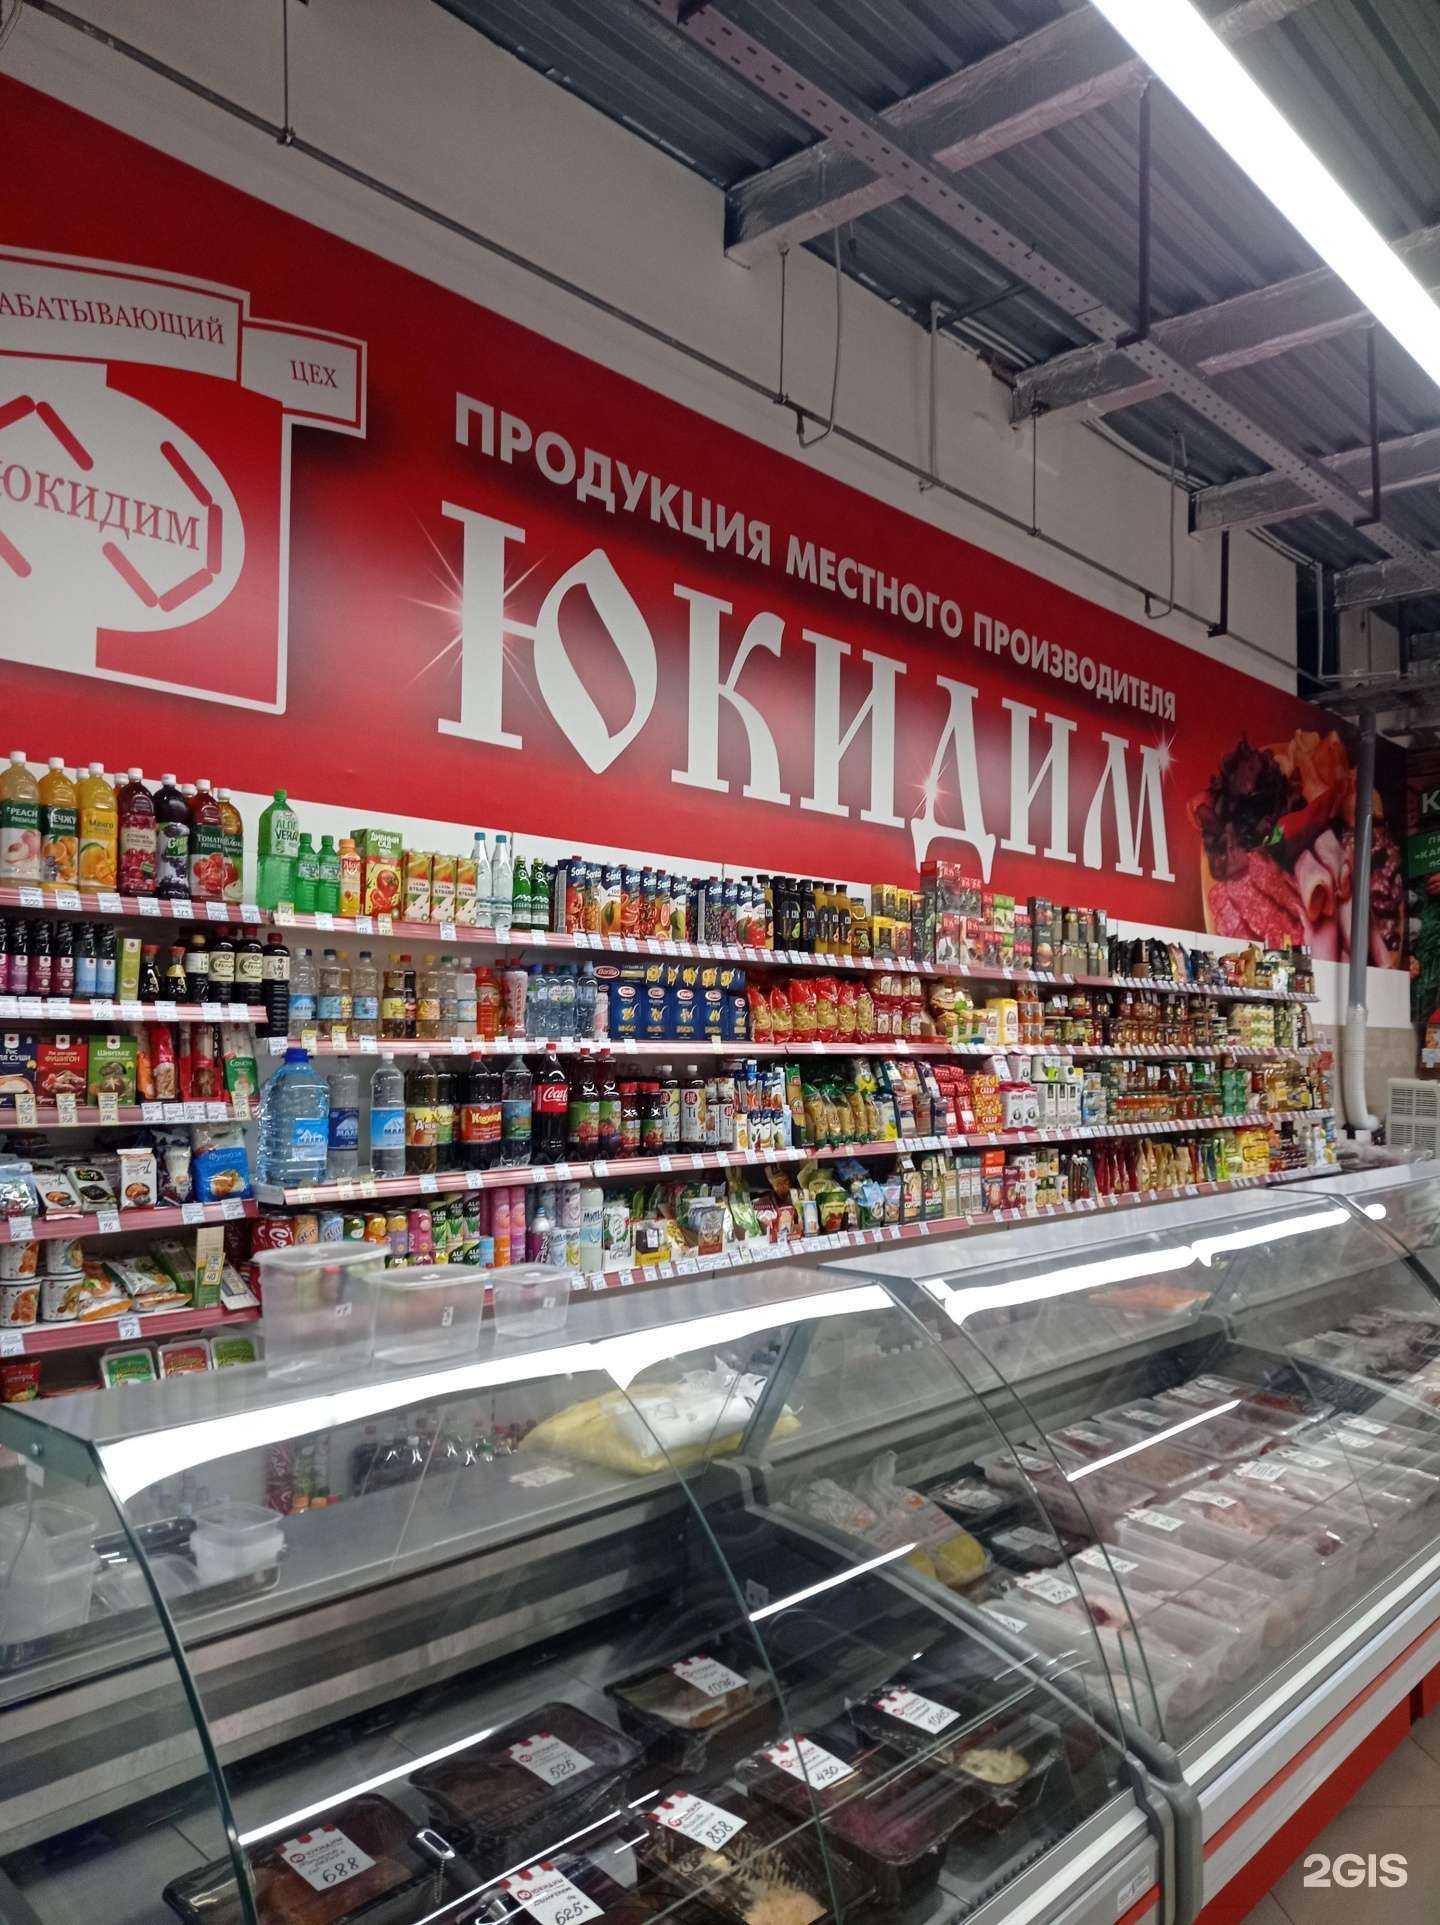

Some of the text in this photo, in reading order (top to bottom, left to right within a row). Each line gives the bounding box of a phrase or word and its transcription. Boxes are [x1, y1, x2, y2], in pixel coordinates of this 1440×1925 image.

[290, 359, 338, 389] ЦЕХ
[0, 460, 202, 552] ЮКИДИМ
[455, 392, 1176, 722] ПРОДУКЦИЯ МЕСТНОГО ПРОИЗВОДИТЕЛЯ
[437, 500, 1177, 884] ЮКИДИМ
[10, 807, 39, 818] PEACH
[274, 829, 298, 842] VERA
[705, 1820, 734, 1844] 858
[321, 1856, 360, 1883] 688
